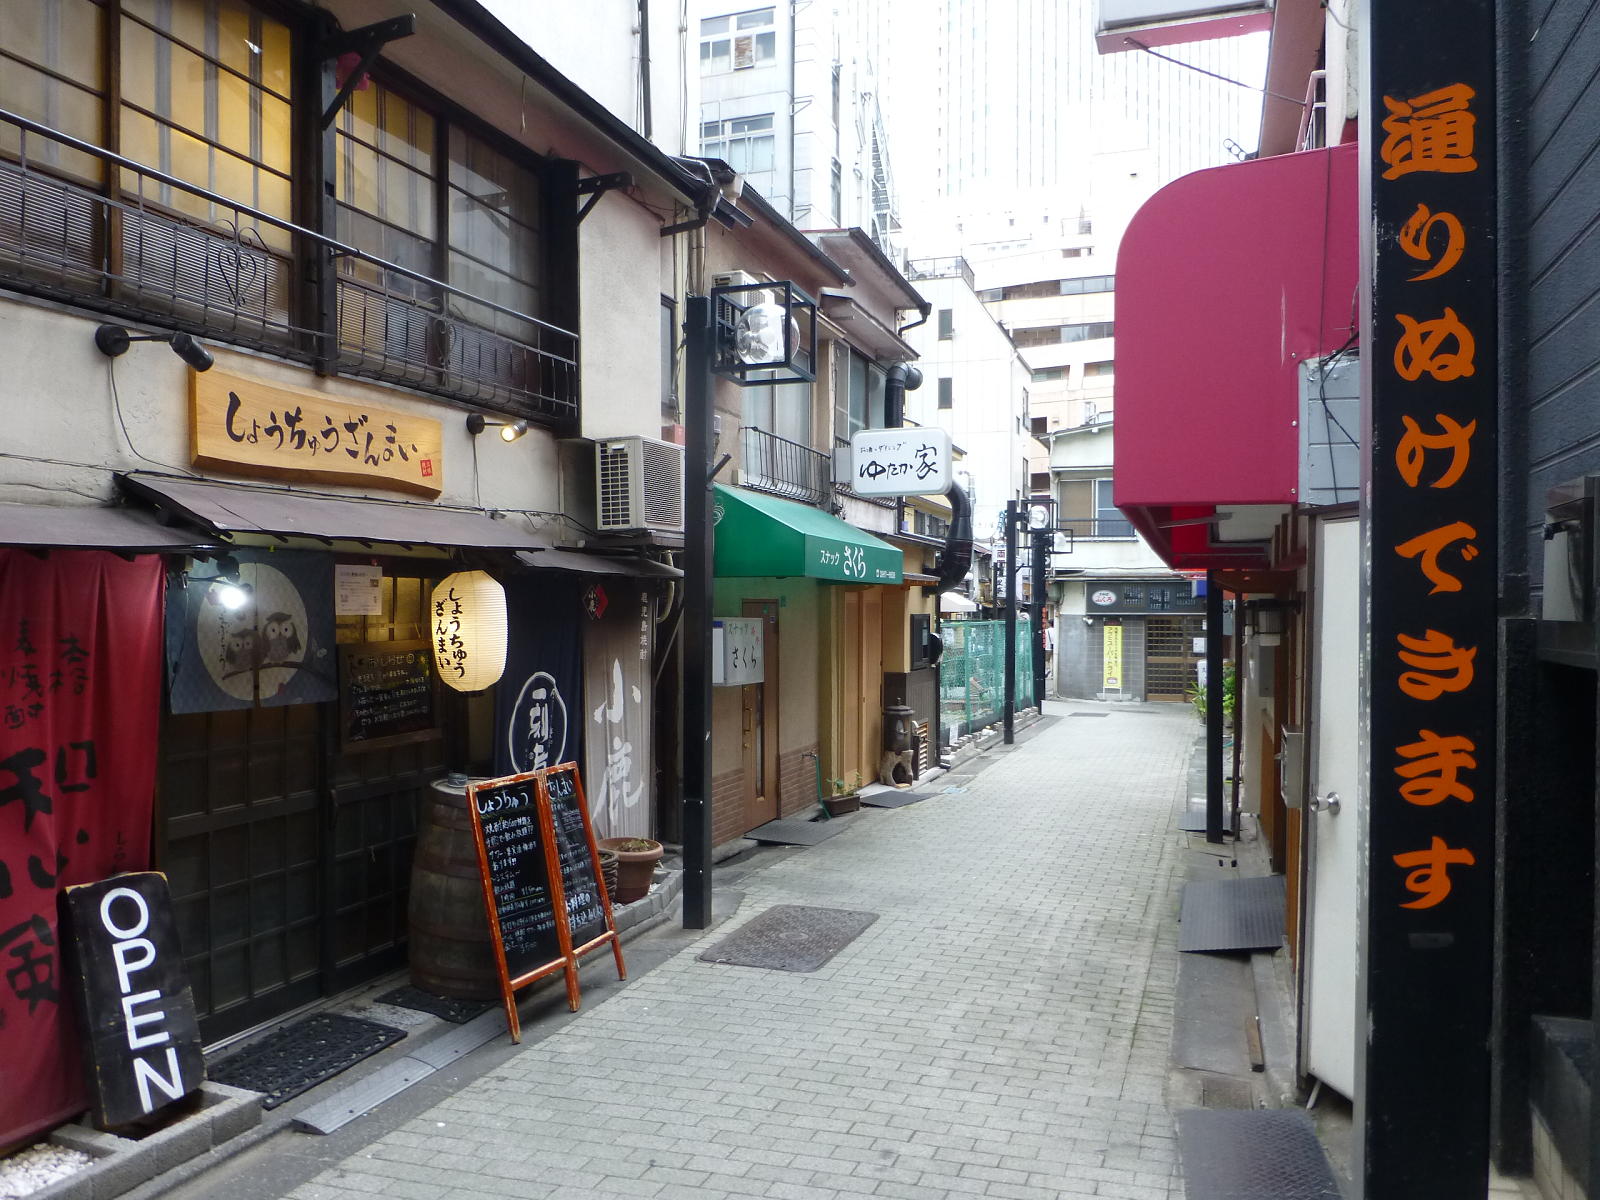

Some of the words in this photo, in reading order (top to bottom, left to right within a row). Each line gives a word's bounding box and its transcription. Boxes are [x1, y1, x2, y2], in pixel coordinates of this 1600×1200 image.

[225, 391, 418, 467] しょうちゅうざんまい
[859, 444, 938, 480] ゆたか家
[1380, 82, 1479, 911] 通りぬけできます
[820, 550, 840, 566] スナック
[843, 545, 867, 578] さくら
[435, 598, 451, 669] ざんまい
[448, 587, 468, 679] しょうちゅう
[732, 646, 757, 669] さくら
[100, 887, 184, 1114] OPEN
